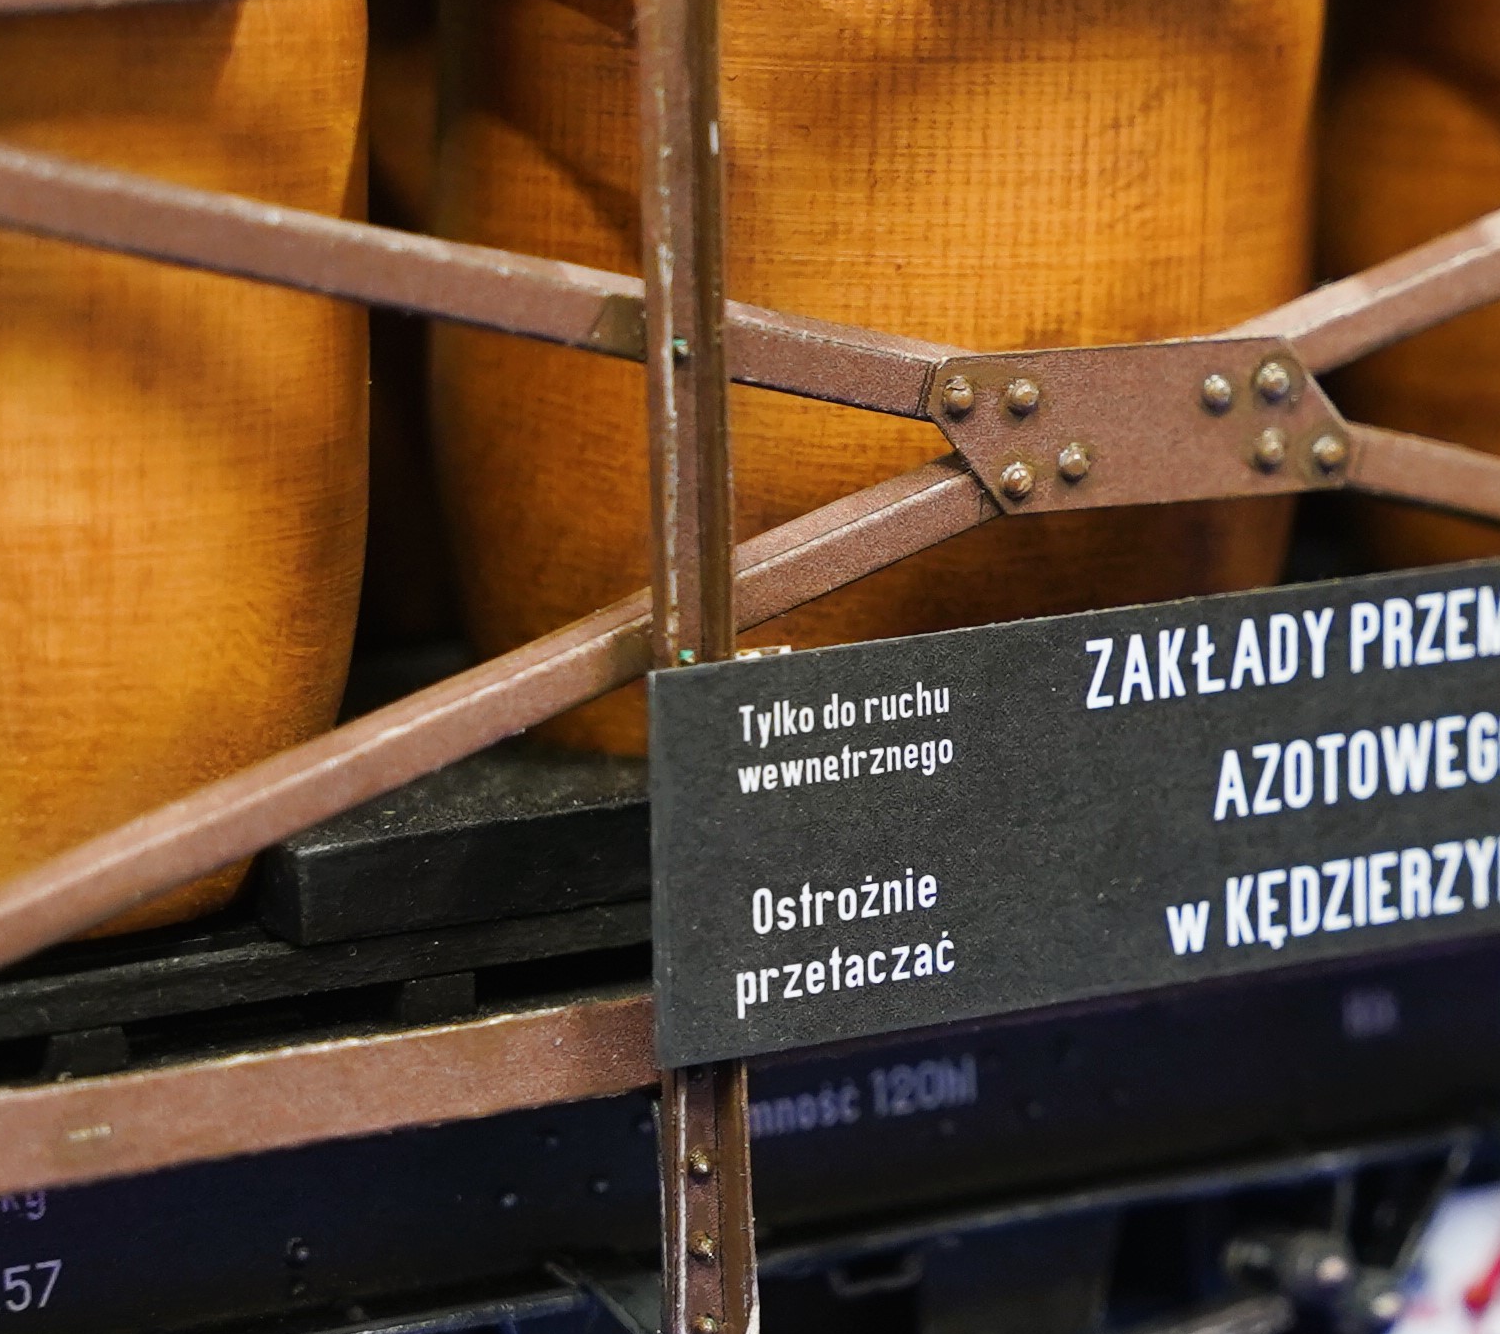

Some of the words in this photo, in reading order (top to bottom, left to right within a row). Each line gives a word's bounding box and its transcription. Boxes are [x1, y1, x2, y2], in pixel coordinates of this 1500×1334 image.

[1085, 608, 1336, 711] ZAKŁADY
[738, 699, 815, 749] Tylko
[823, 692, 856, 730] do
[864, 681, 950, 724] ruchu
[737, 738, 954, 794] wewnętrznego
[752, 867, 938, 935] Ostrożnie
[1165, 900, 1210, 956] w
[736, 930, 955, 1020] przetaczać
